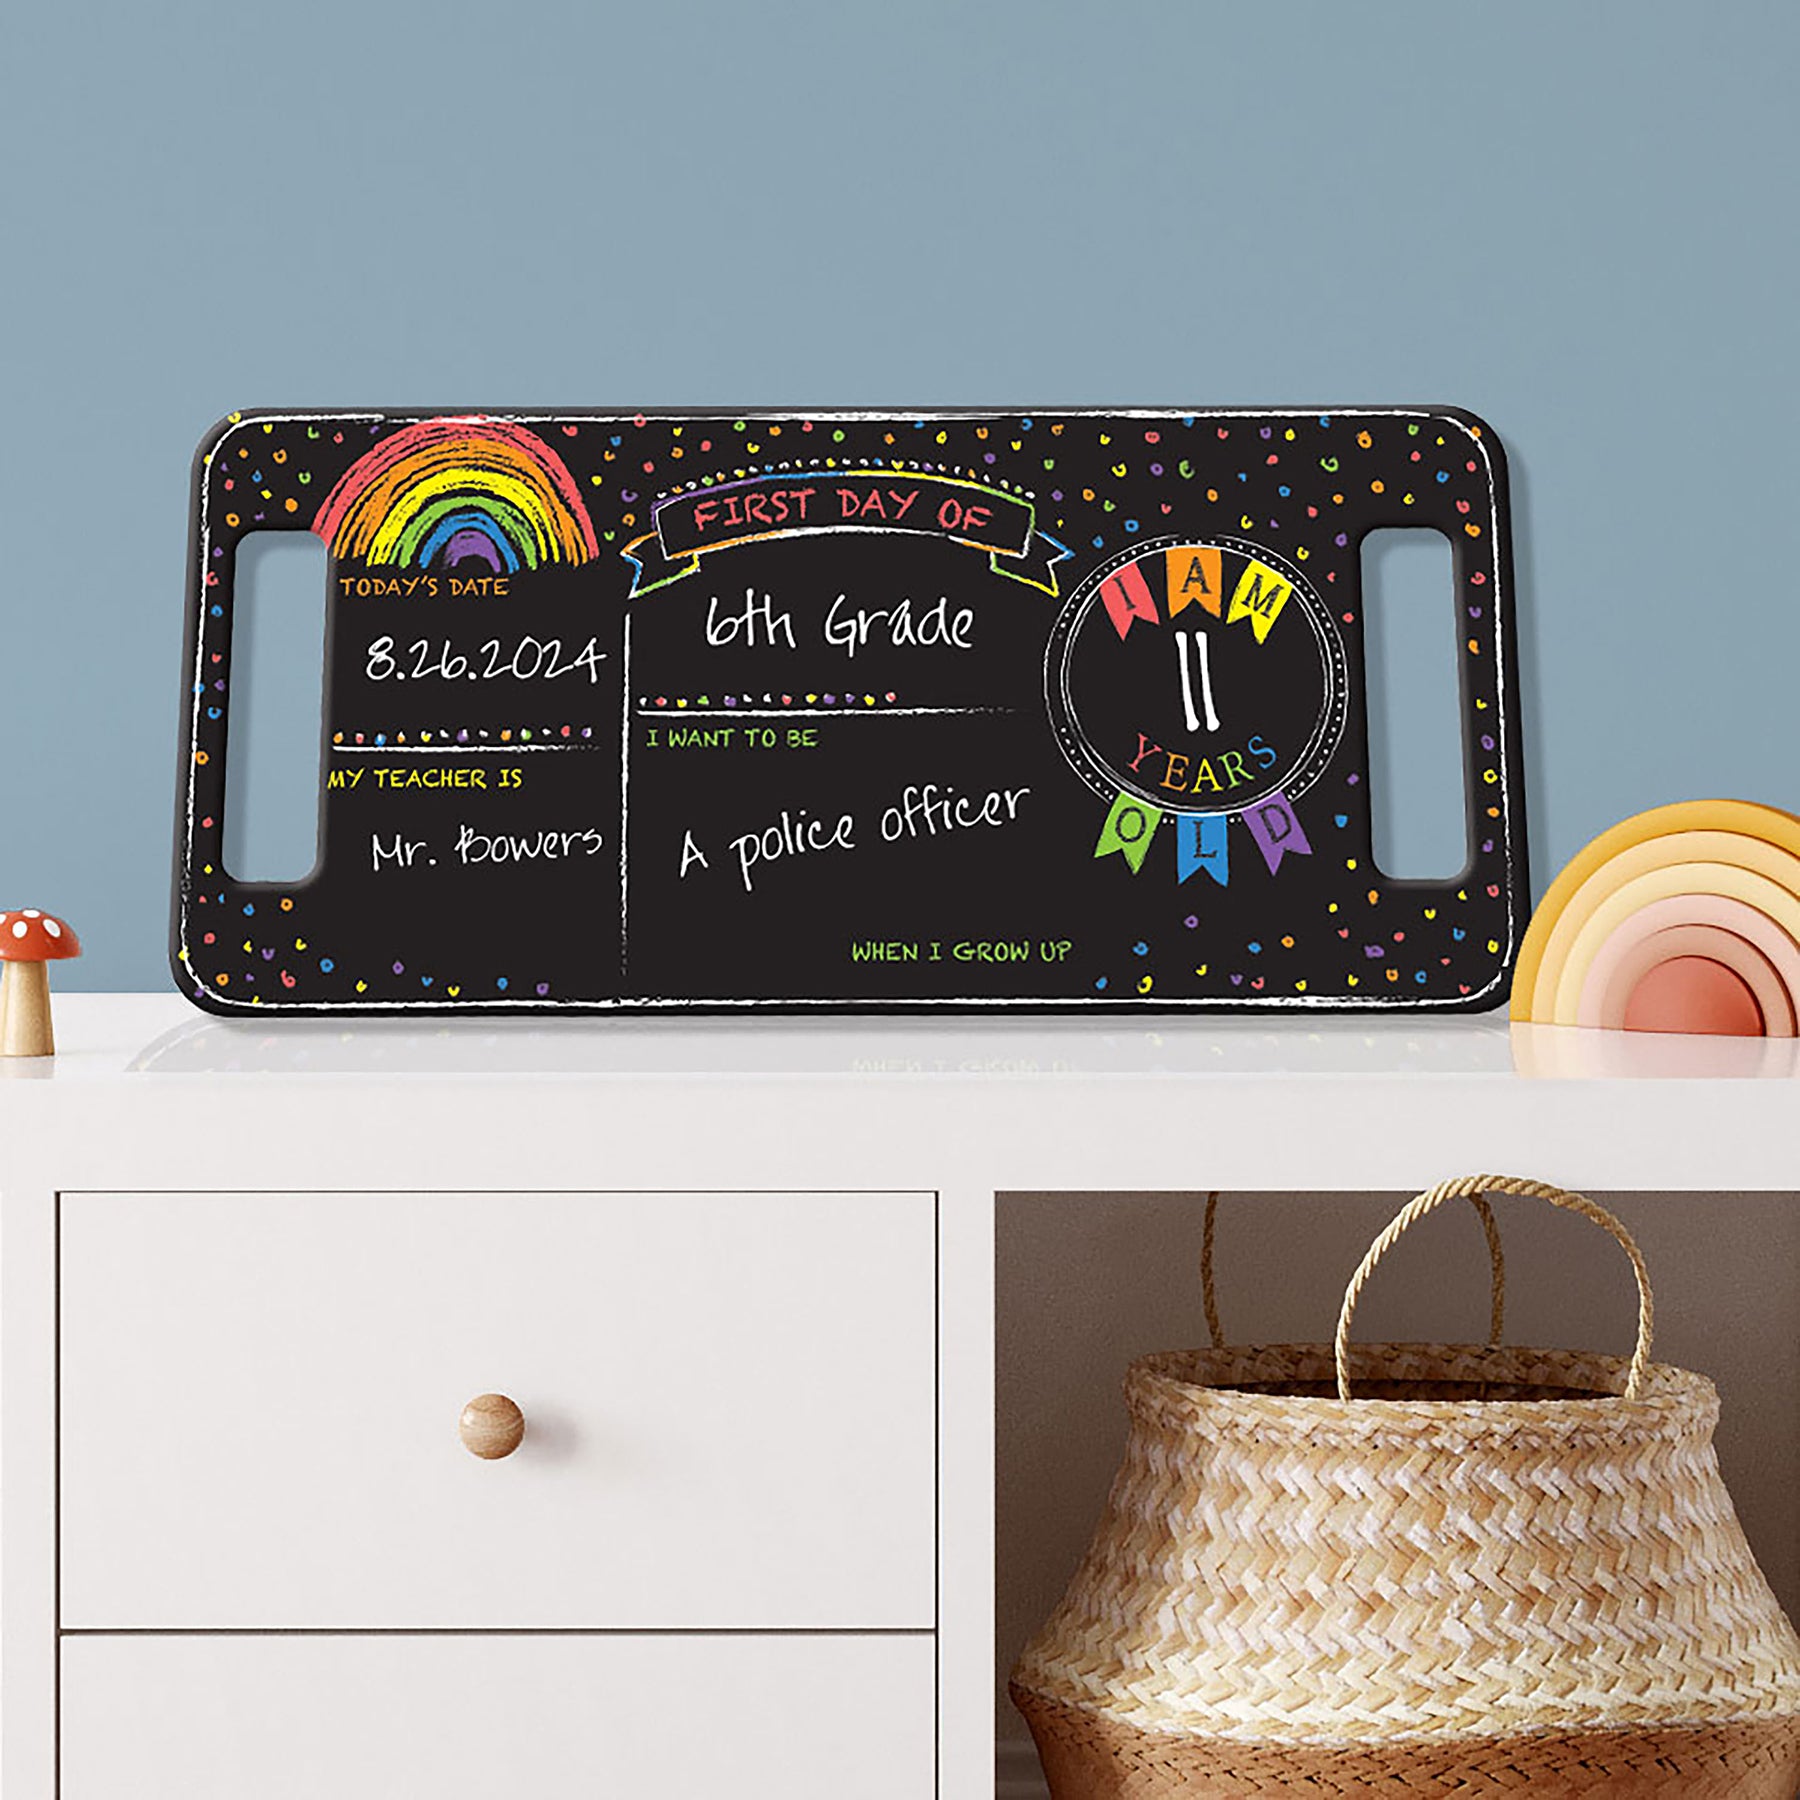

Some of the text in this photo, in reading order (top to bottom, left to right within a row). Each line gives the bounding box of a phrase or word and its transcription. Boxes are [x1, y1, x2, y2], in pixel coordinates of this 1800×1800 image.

[693, 488, 996, 532] FIRST DAY OF
[340, 575, 508, 596] TODAY'S DATE
[707, 588, 973, 657] 6th Grade
[366, 636, 606, 683] 8.26.2024
[647, 728, 817, 747] I WANT TO BE
[327, 768, 521, 789] MY TEACHER IS
[1128, 732, 1278, 793] YEARS
[373, 825, 602, 871] Mr. Bowers
[681, 785, 1030, 891] A police officer
[853, 941, 1071, 962] WHEN I GROW UP
